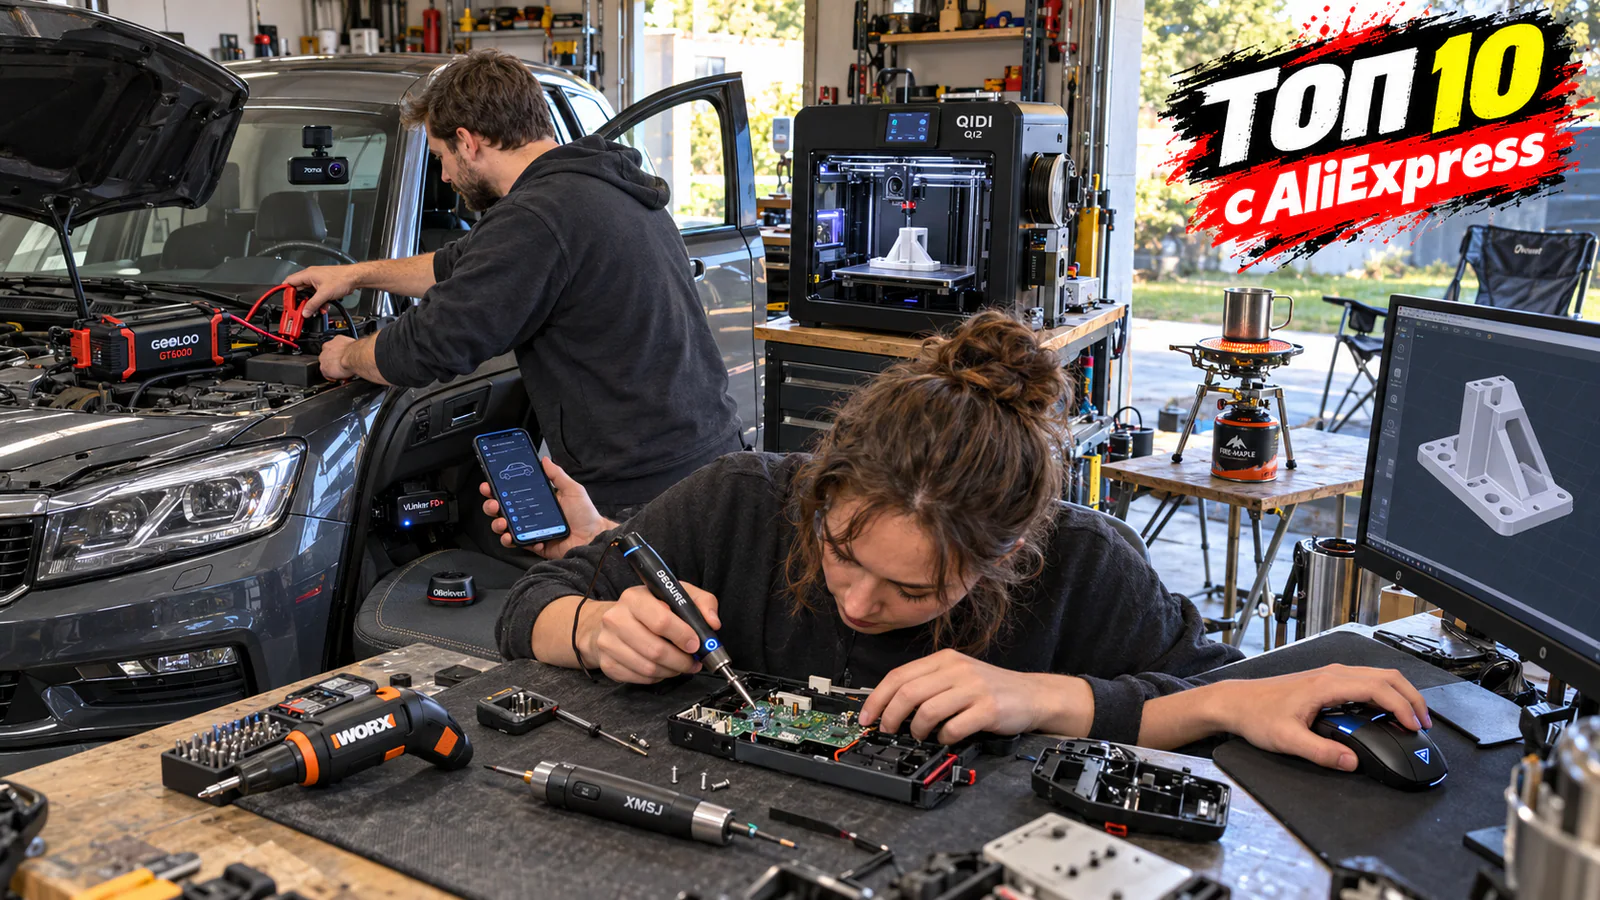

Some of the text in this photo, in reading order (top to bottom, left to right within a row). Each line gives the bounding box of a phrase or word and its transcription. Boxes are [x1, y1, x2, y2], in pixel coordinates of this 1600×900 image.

[956, 115, 993, 128] QIDI
[159, 347, 193, 361] GT6000
[335, 713, 397, 747] WORX
[623, 795, 664, 816] XMSJ
